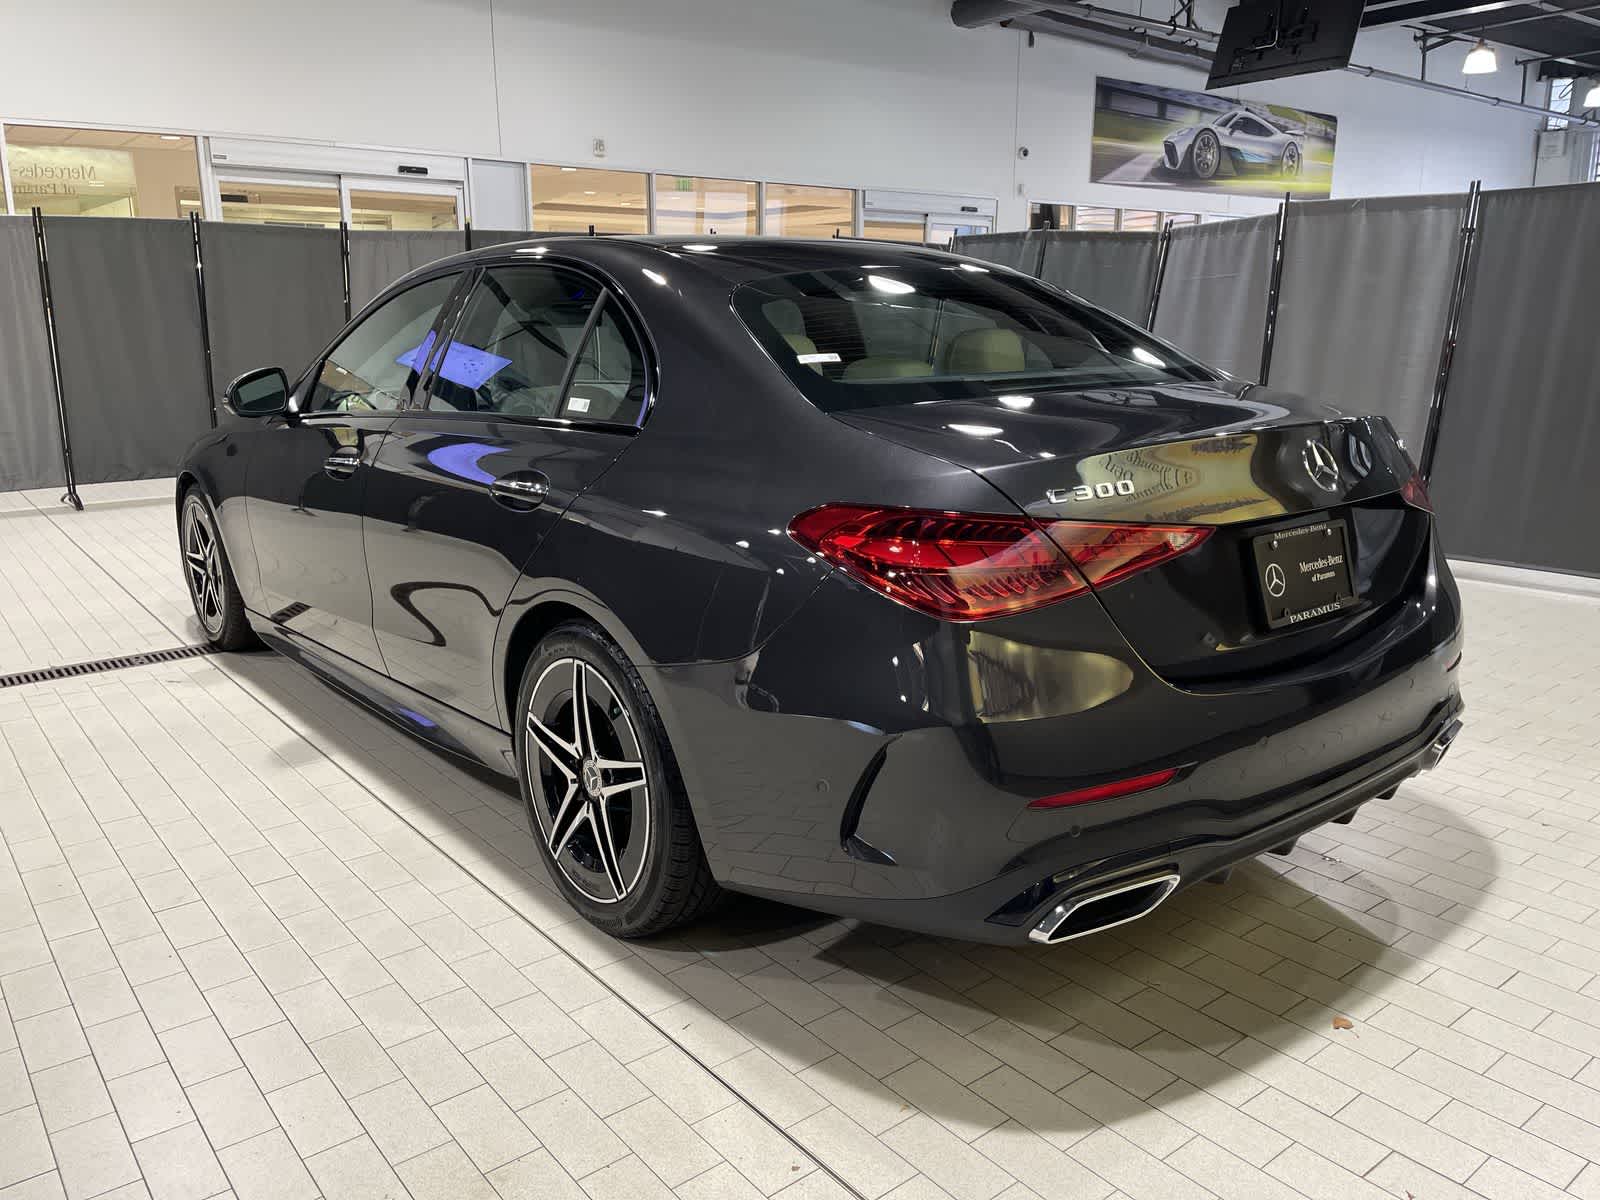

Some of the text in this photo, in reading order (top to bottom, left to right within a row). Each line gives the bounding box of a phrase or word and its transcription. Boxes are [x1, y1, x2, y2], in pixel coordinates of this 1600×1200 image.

[1046, 479, 1135, 504] C 300
[1274, 523, 1327, 540] Mercedes-Benz
[1299, 554, 1343, 573] Mercedes-Benz
[1289, 602, 1341, 623] PARAMUS
